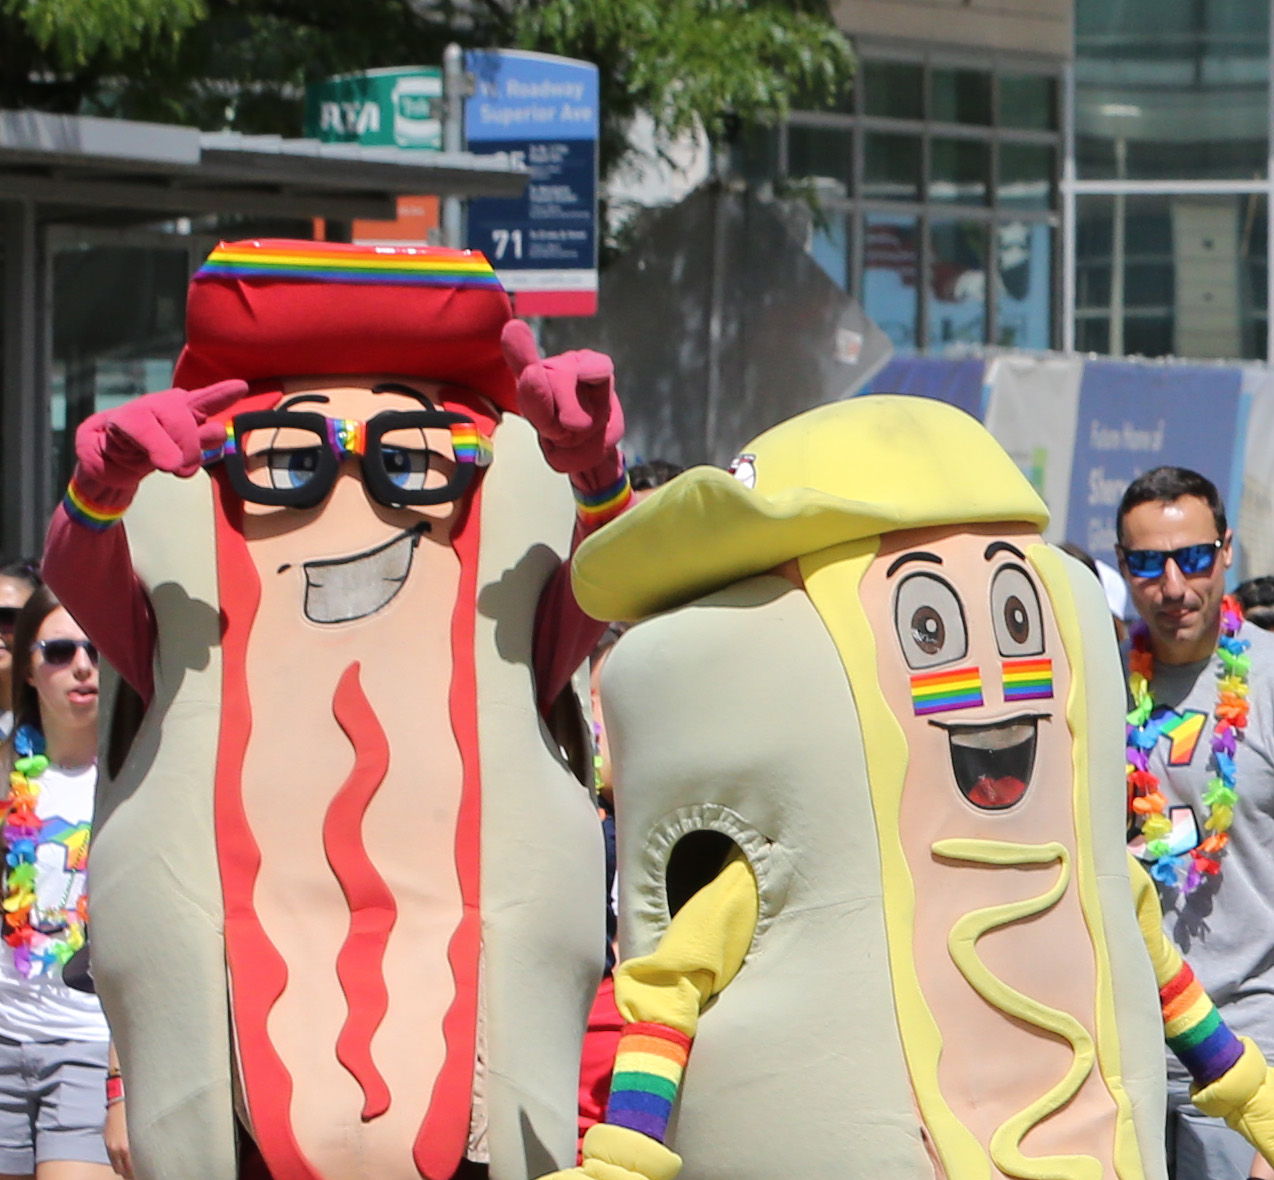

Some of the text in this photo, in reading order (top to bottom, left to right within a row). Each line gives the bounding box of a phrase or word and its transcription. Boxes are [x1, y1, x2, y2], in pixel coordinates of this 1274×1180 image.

[320, 101, 381, 135] RTA
[561, 102, 593, 122] Ave
[491, 228, 523, 260] 71
